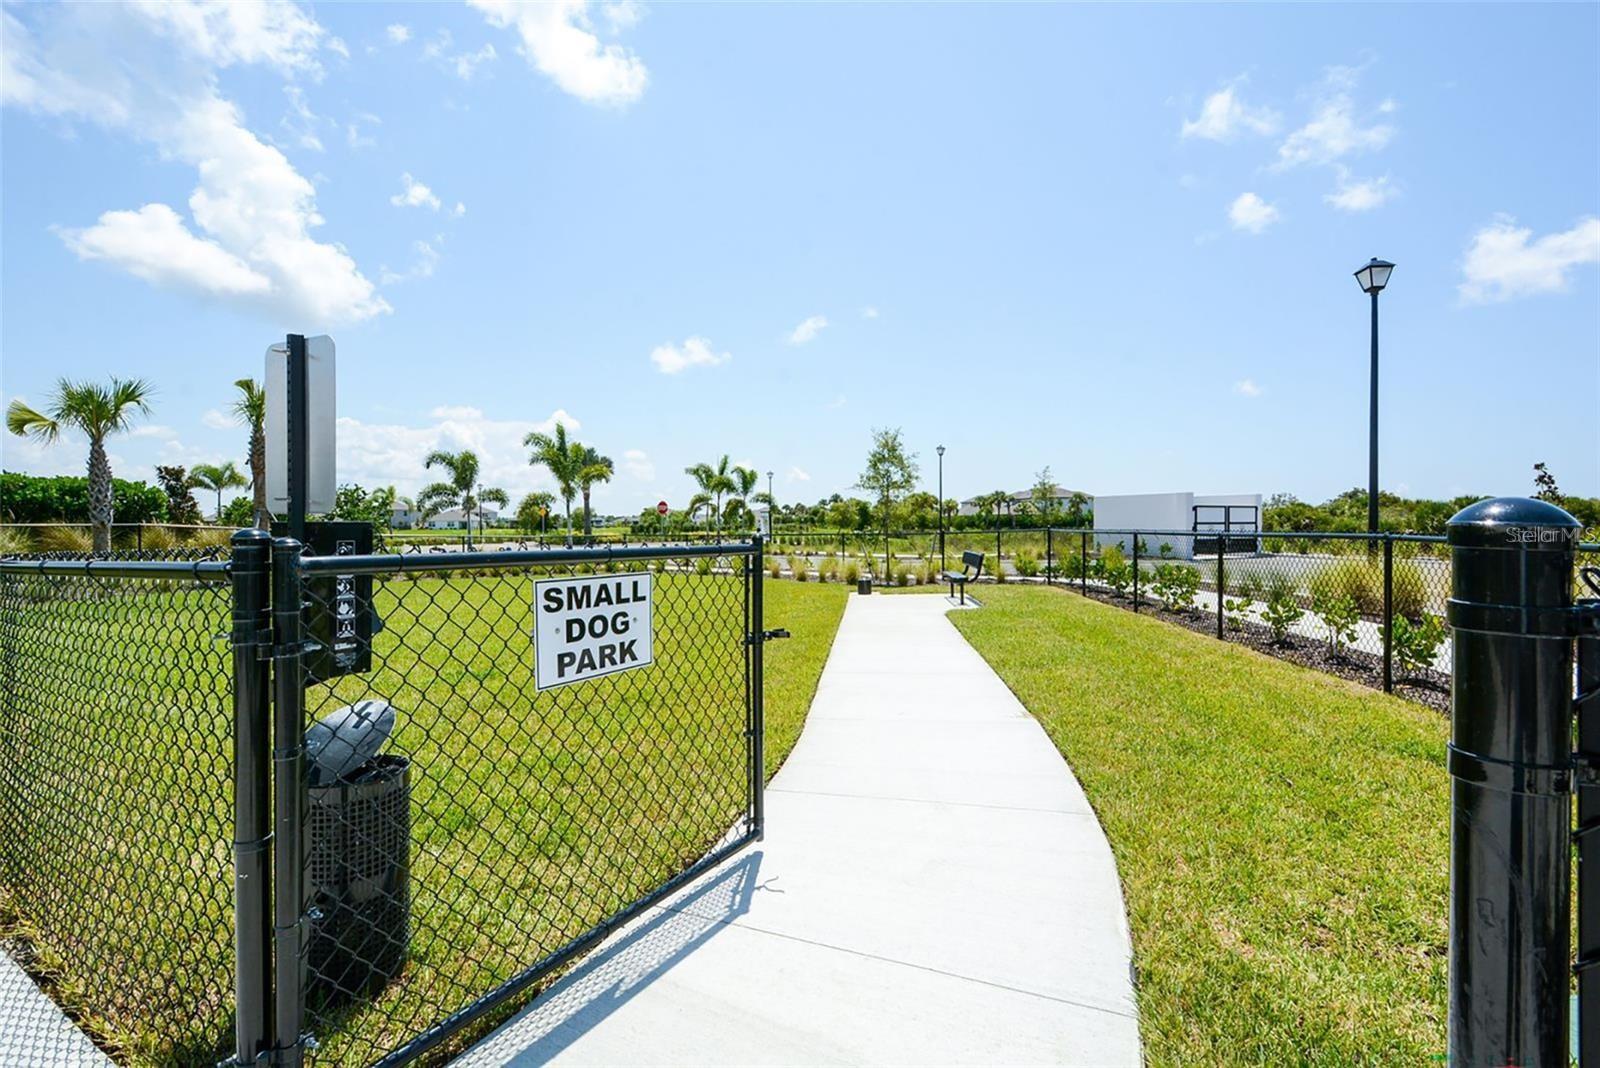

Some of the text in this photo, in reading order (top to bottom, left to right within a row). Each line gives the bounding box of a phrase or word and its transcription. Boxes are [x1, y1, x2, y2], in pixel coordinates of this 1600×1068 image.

[543, 580, 647, 613] SMALL
[565, 611, 630, 644] DOG
[557, 639, 638, 679] PARK
